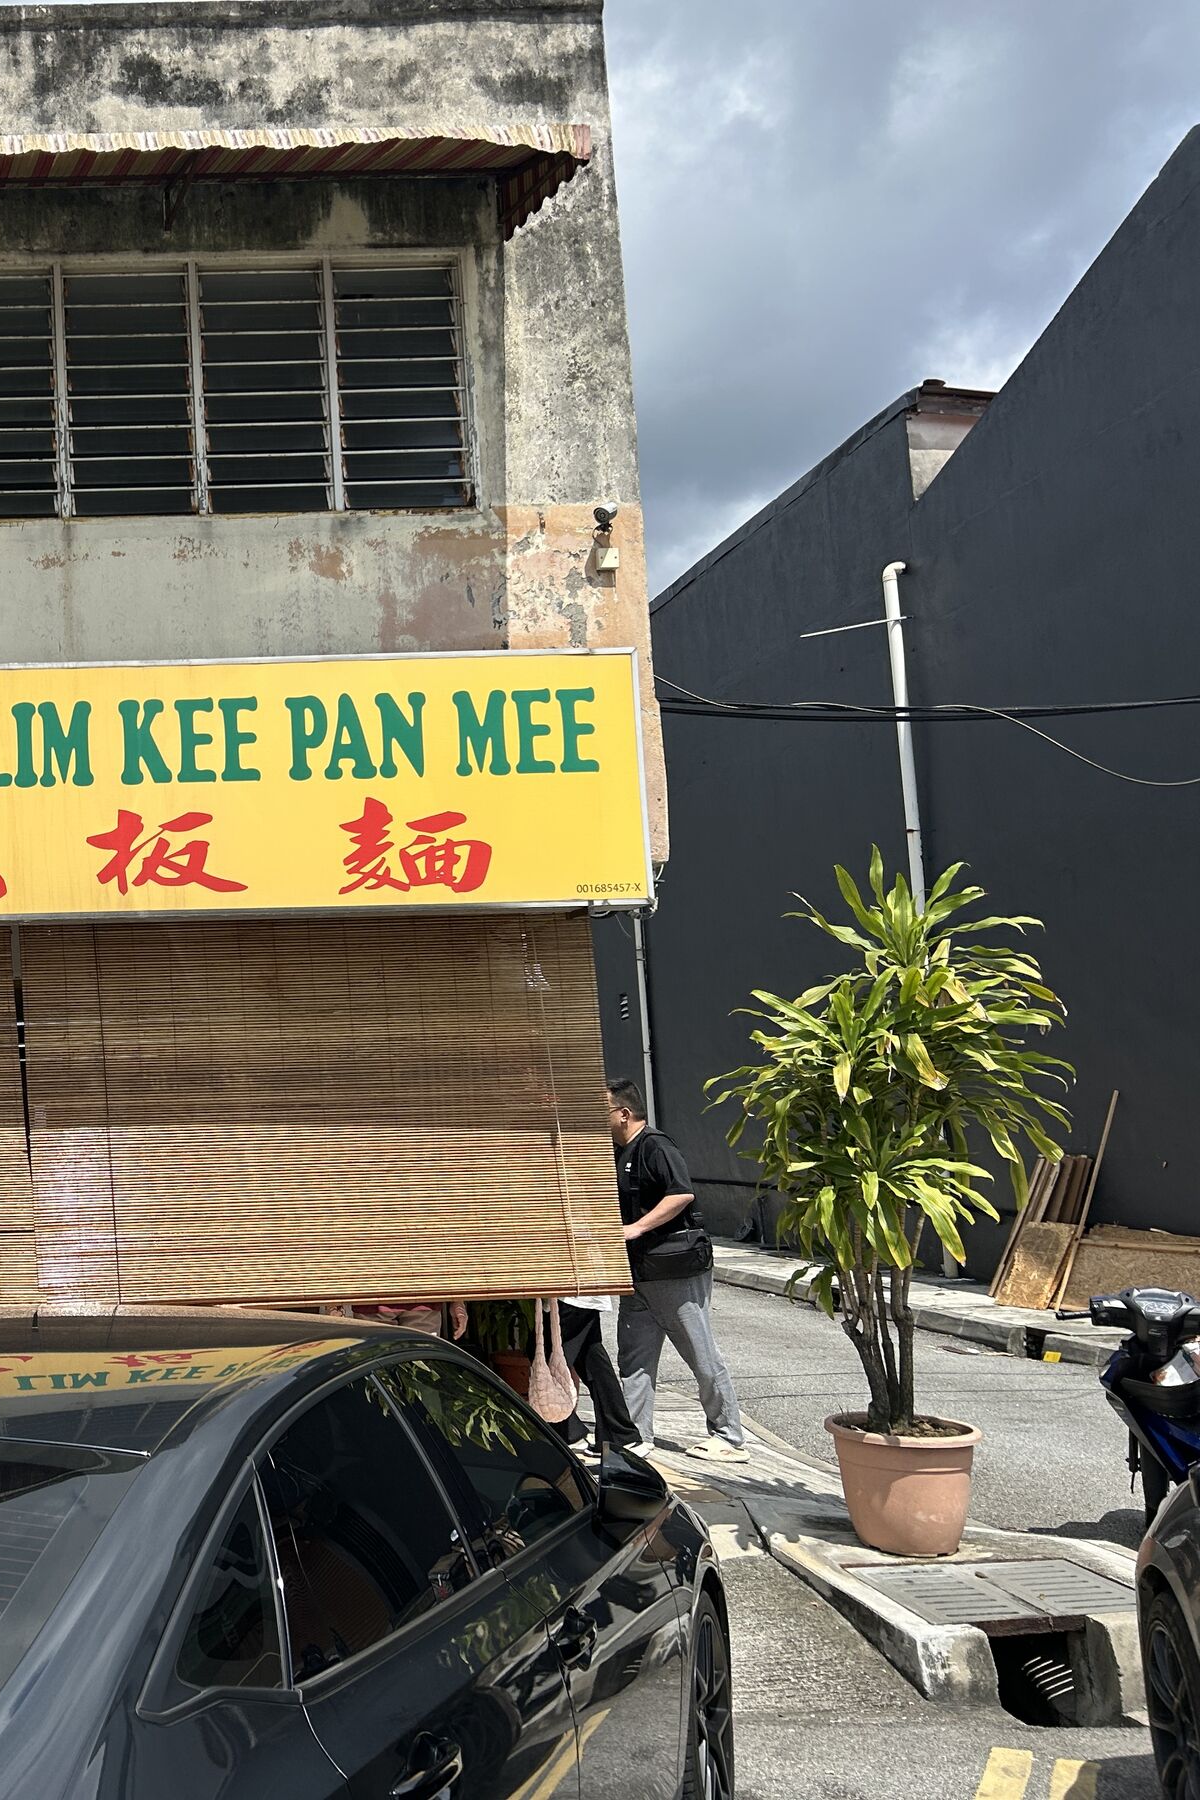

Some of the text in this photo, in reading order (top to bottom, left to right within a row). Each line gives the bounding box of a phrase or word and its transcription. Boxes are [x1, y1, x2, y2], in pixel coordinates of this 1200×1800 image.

[118, 696, 262, 786] KEE
[284, 692, 426, 781] PAN
[451, 687, 600, 777] MEE
[576, 883, 642, 894] 001685457-X
